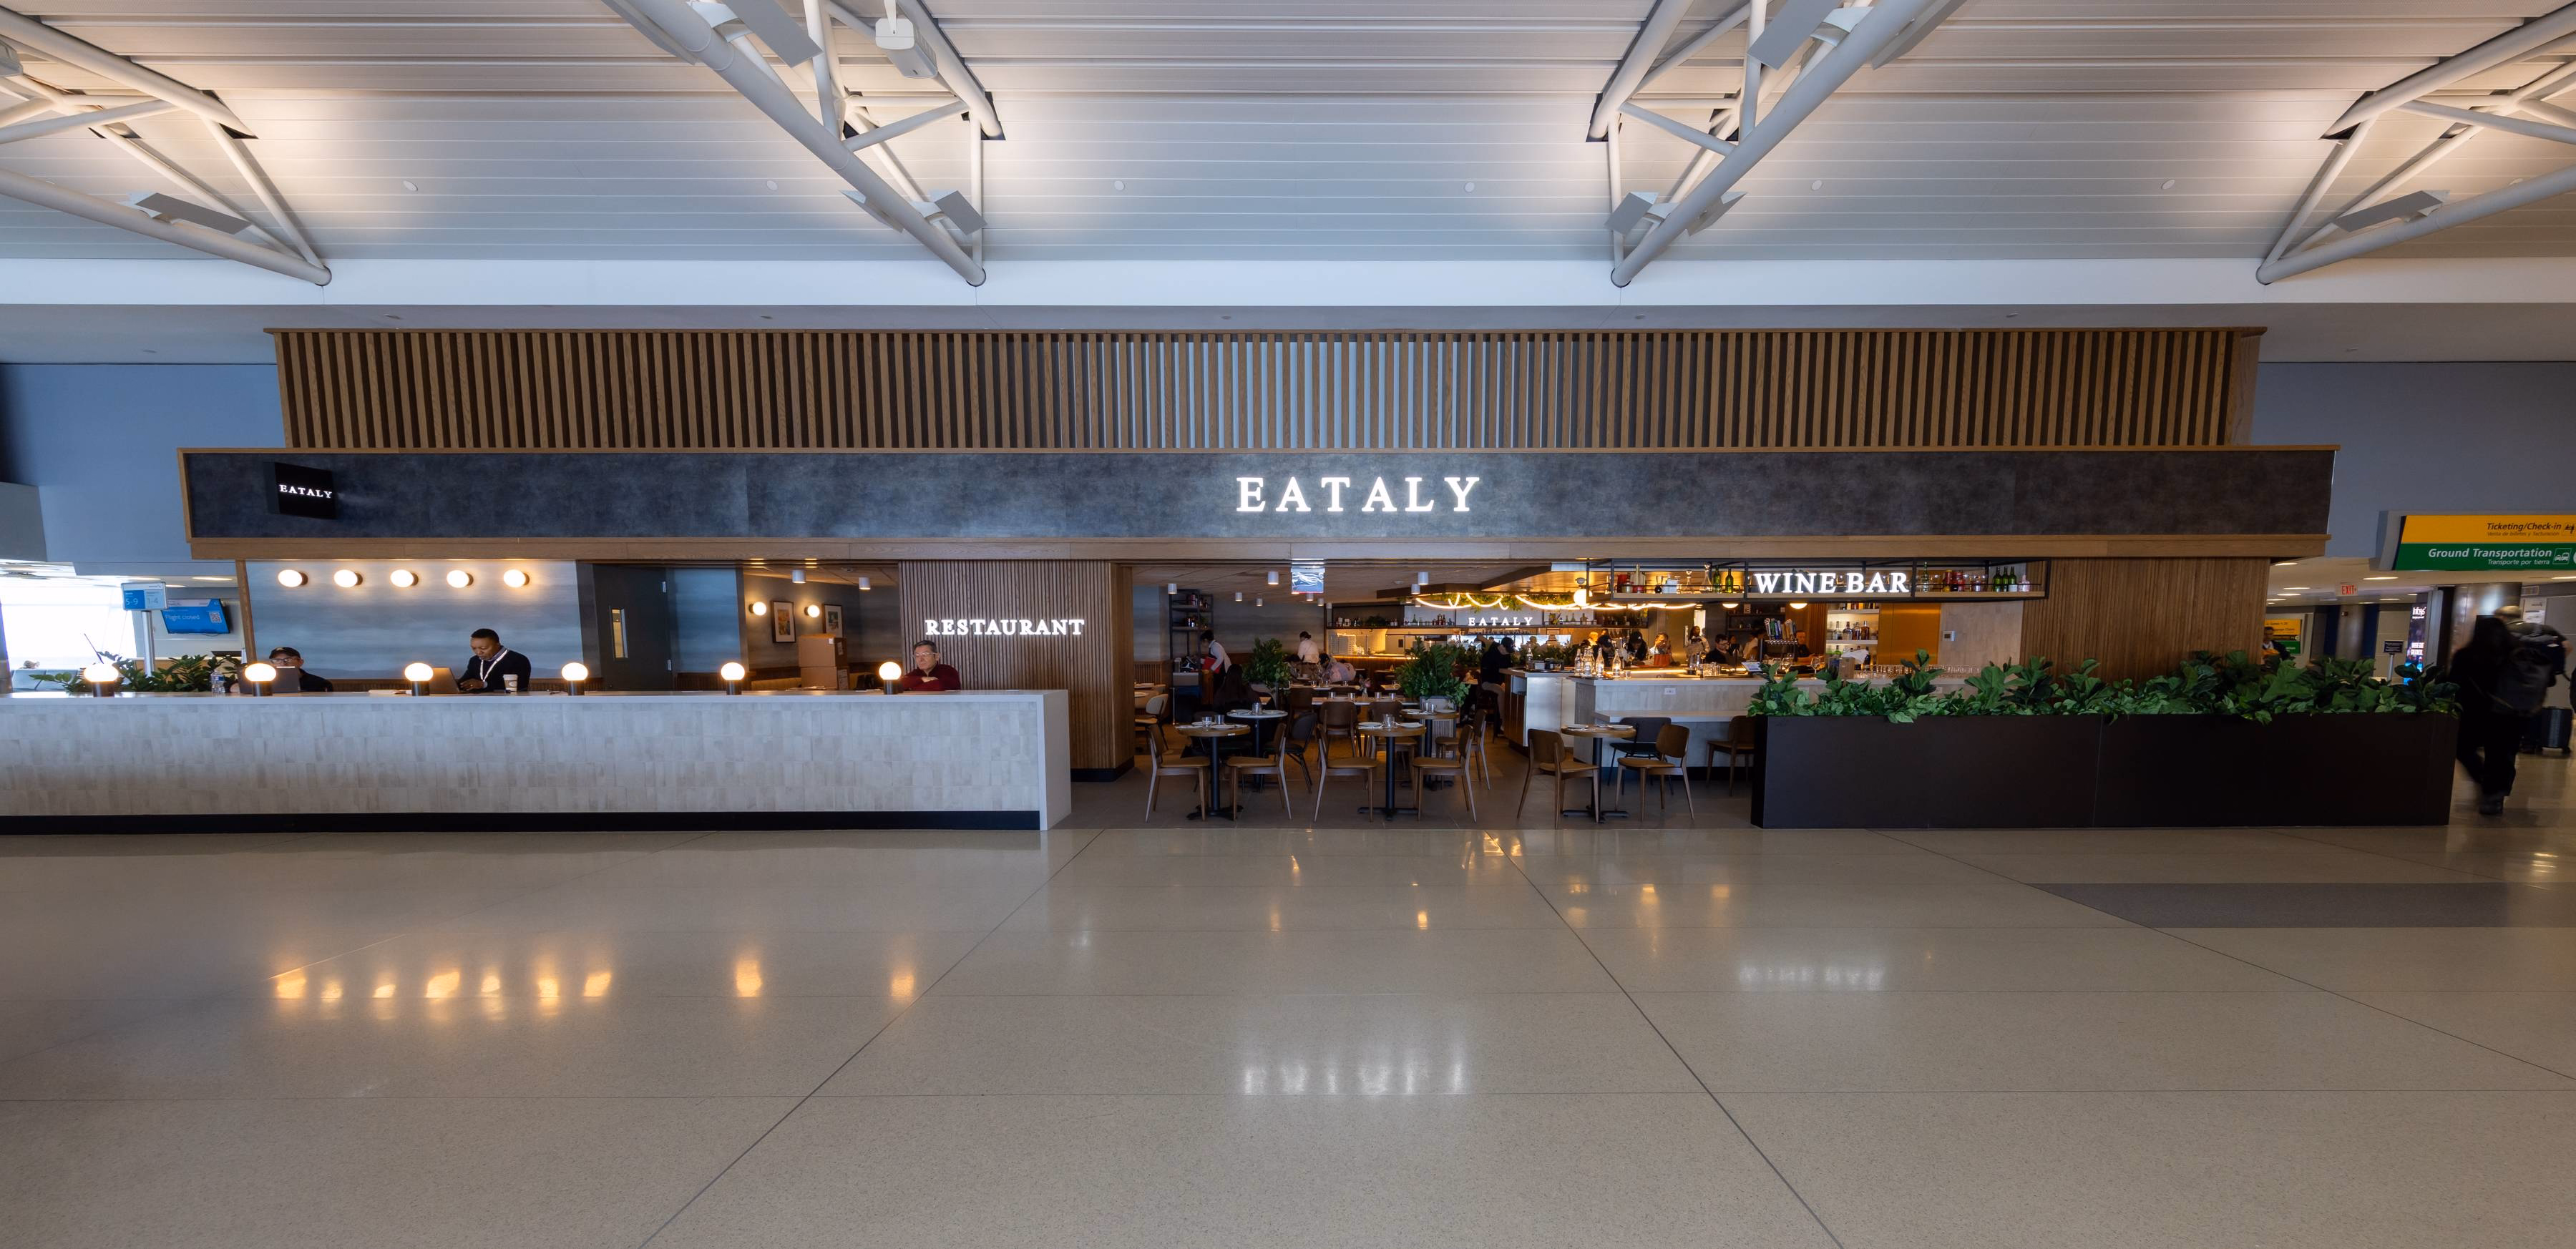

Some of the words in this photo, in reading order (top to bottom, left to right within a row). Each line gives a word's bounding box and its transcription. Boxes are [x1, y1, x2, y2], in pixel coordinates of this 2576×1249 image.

[279, 484, 332, 499] EATALY
[1236, 476, 1480, 512] EATALY
[2487, 522, 2562, 532] Ticketing/Check-in
[2429, 548, 2469, 558] Ground
[2473, 548, 2552, 559] Transportation
[1755, 572, 1837, 594] WINE
[1845, 572, 1909, 593] BAR
[2341, 585, 2354, 595] EXIT
[925, 619, 1085, 635] RESTAURANT
[1468, 617, 1533, 626] EATALY
